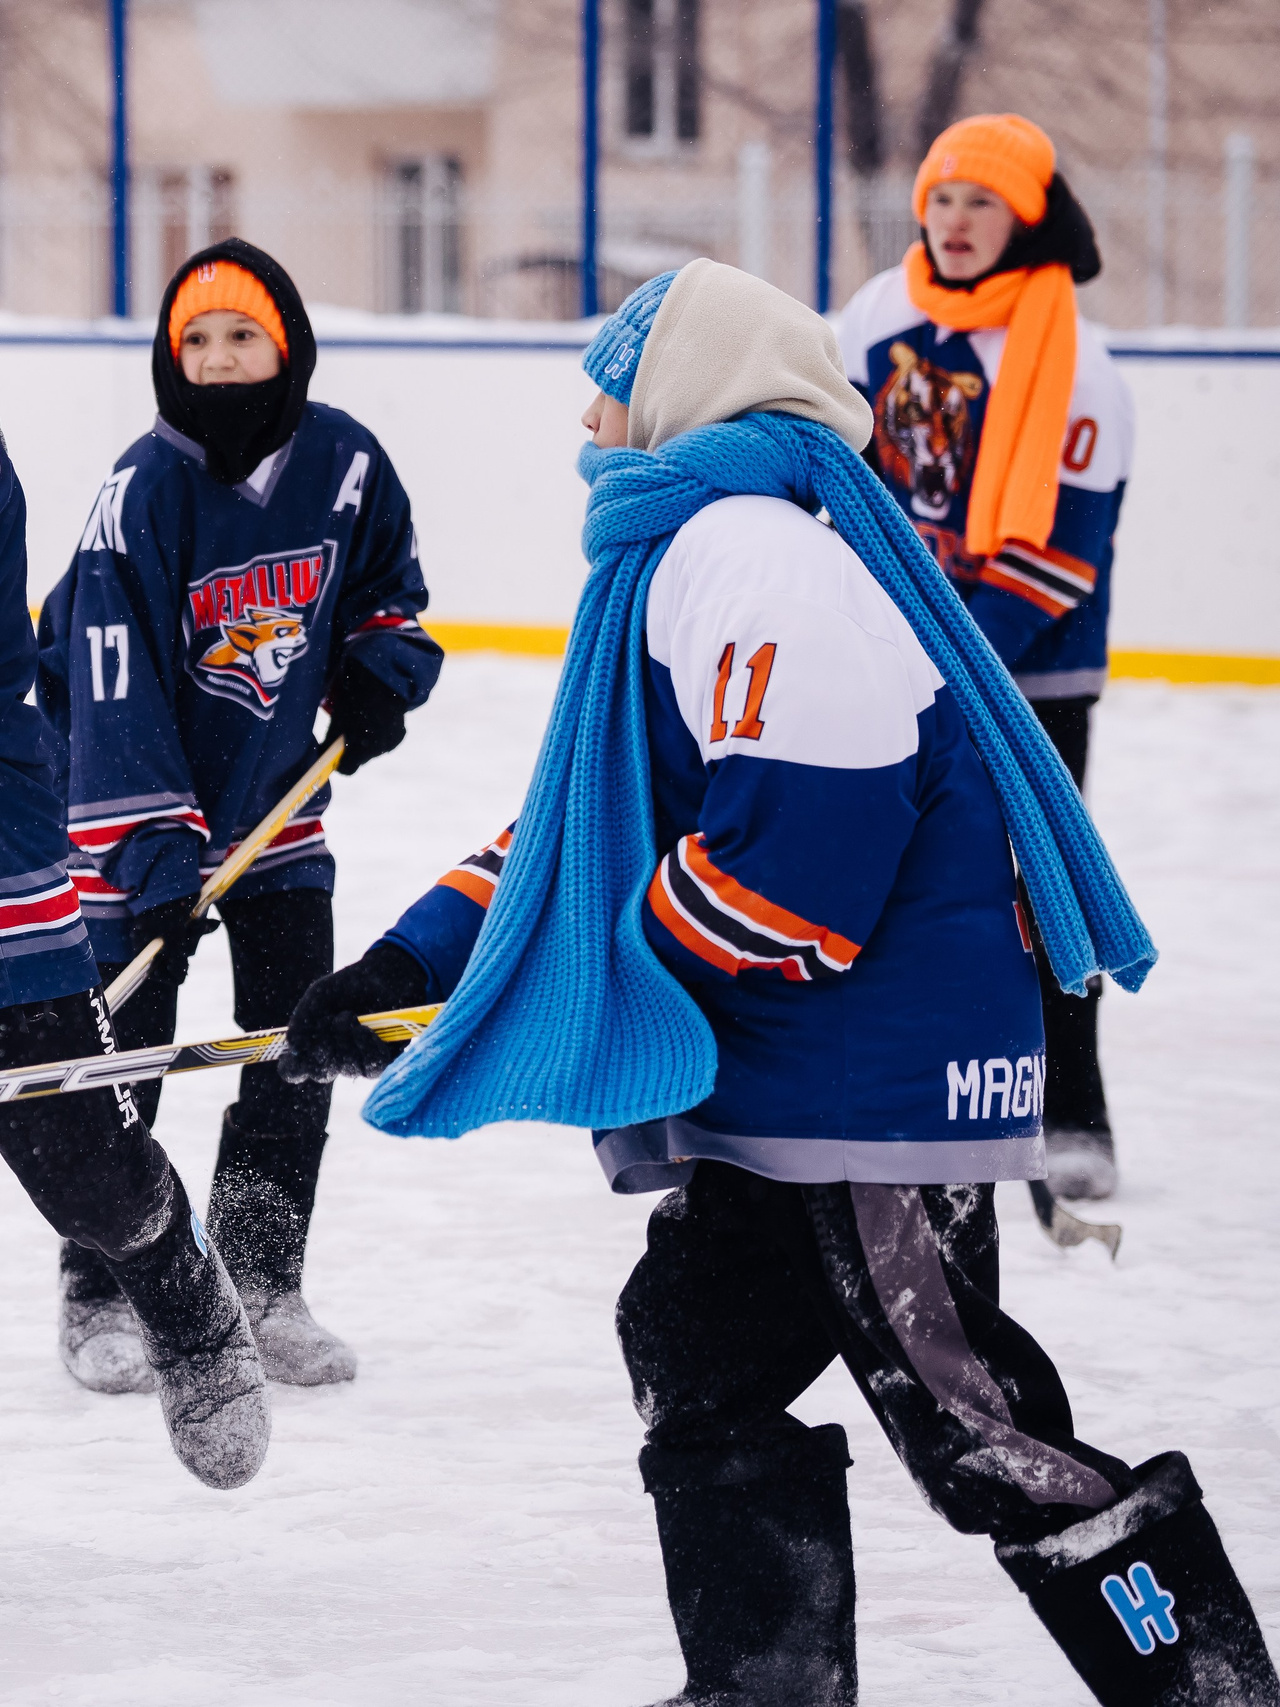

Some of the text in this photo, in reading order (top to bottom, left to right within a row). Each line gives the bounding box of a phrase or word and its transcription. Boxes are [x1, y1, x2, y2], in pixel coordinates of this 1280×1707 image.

[332, 450, 370, 516] A
[86, 624, 129, 702] 17
[709, 641, 778, 744] 11
